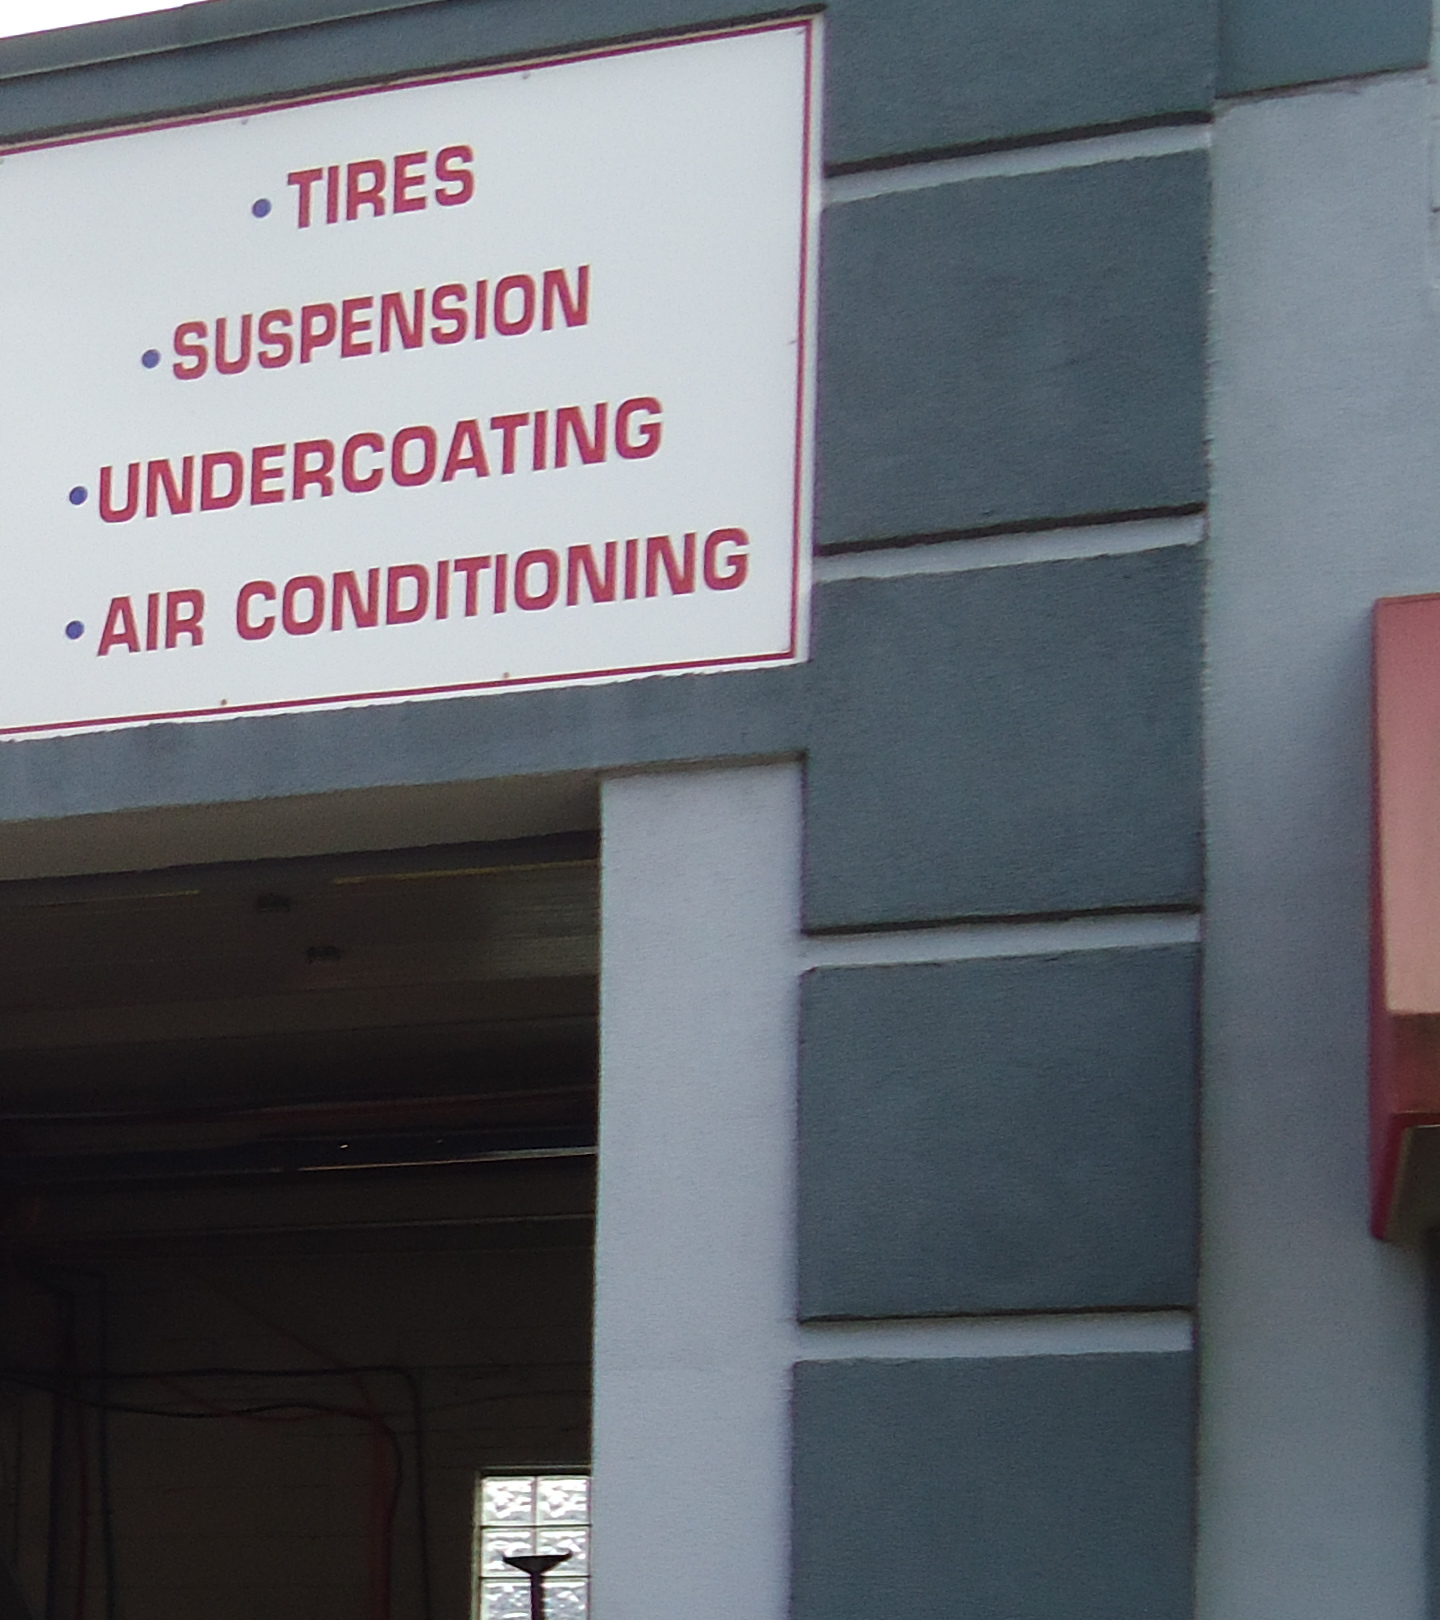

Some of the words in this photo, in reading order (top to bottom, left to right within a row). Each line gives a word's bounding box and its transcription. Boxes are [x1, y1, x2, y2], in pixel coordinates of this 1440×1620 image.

[286, 144, 476, 229] TIRES
[171, 263, 591, 380] SUSPENSION
[97, 394, 664, 524] UNDERCOATING
[95, 587, 205, 656] AIR
[235, 526, 751, 641] CONDITIONING
